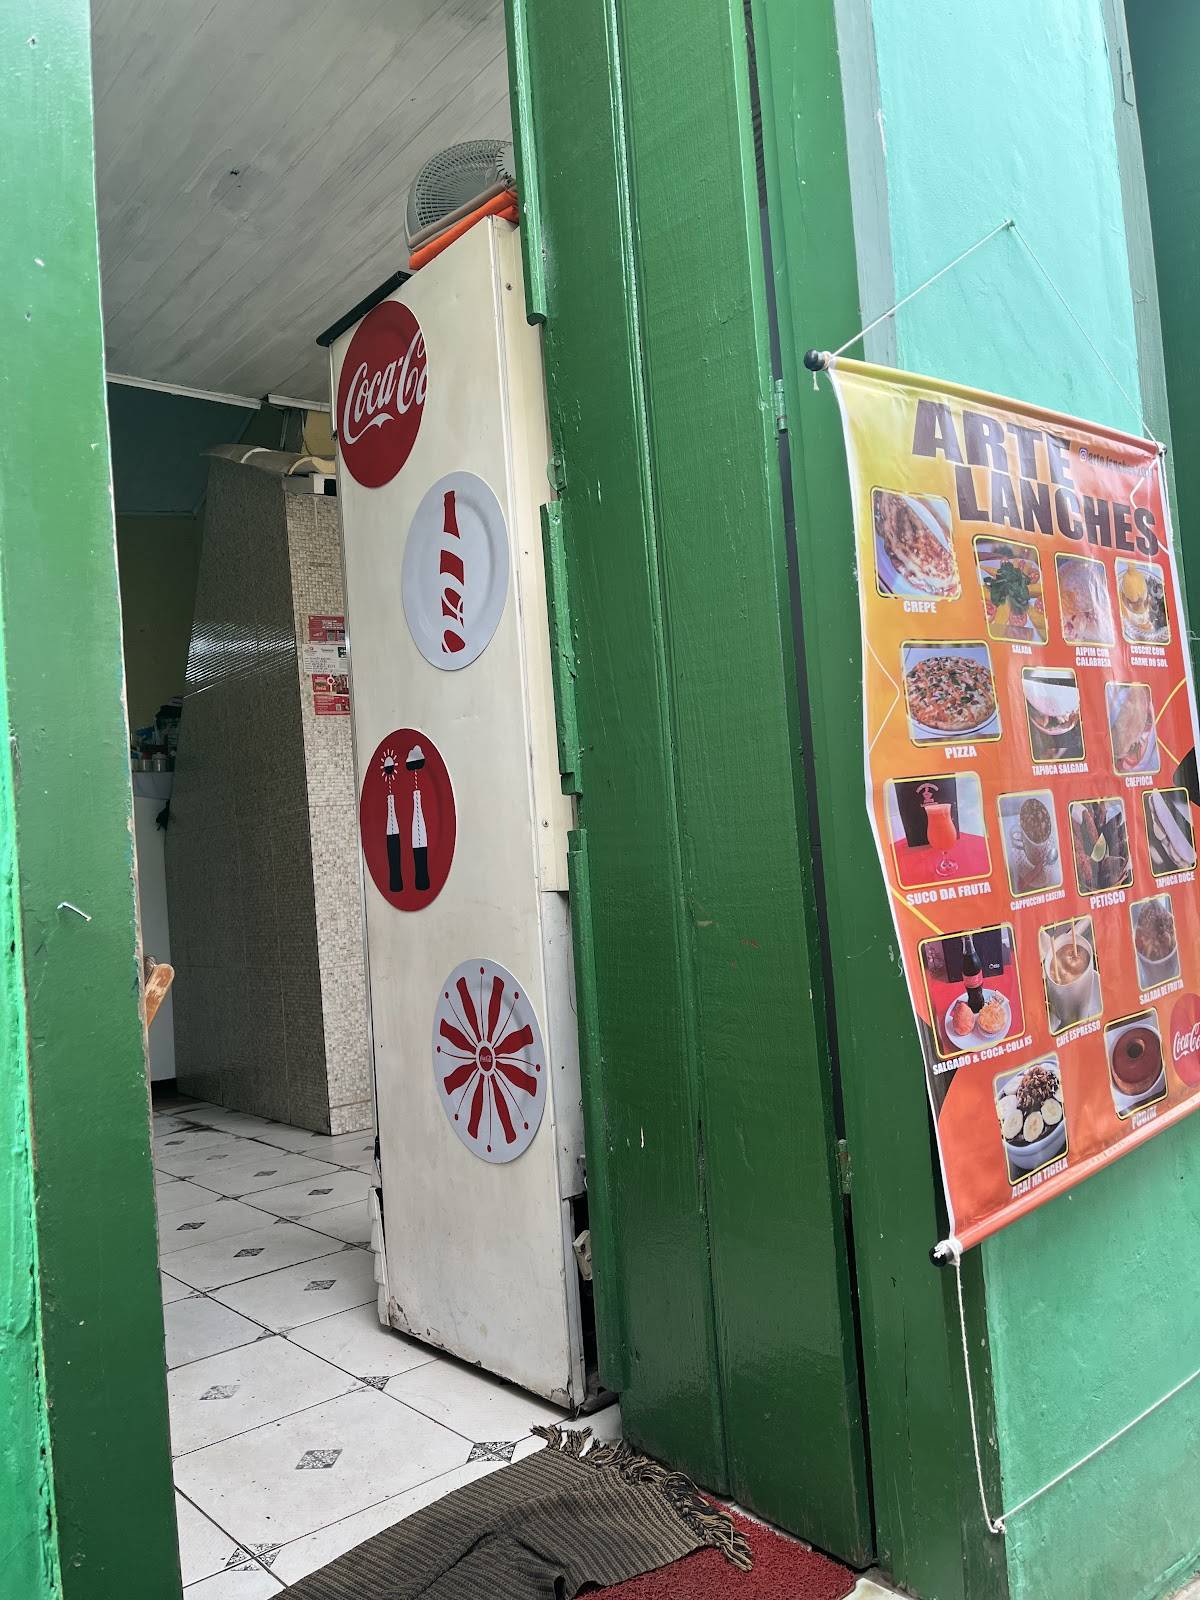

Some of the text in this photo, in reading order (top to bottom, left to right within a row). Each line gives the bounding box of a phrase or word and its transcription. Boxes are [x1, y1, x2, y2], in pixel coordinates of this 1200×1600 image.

[912, 399, 1076, 488] ARTE
[955, 464, 1159, 556] LANCHES
[903, 600, 937, 613] CREPE
[1075, 656, 1112, 667] CALABRESA
[1157, 659, 1169, 668] SOL
[944, 745, 977, 759] PIZZA
[1032, 763, 1089, 776] TAPIOCA SALGADA
[1125, 775, 1154, 788] CREPIOCA
[1155, 871, 1196, 889] TAPIOCA DOCE
[906, 881, 992, 906] SUCO DA FRUTA
[1090, 890, 1126, 910] PETISCO
[1069, 1019, 1101, 1041] ESPRESSO
[932, 1055, 971, 1075] SALGADO
[972, 1053, 980, 1064] &
[980, 1041, 1024, 1061] COCA-COLA
